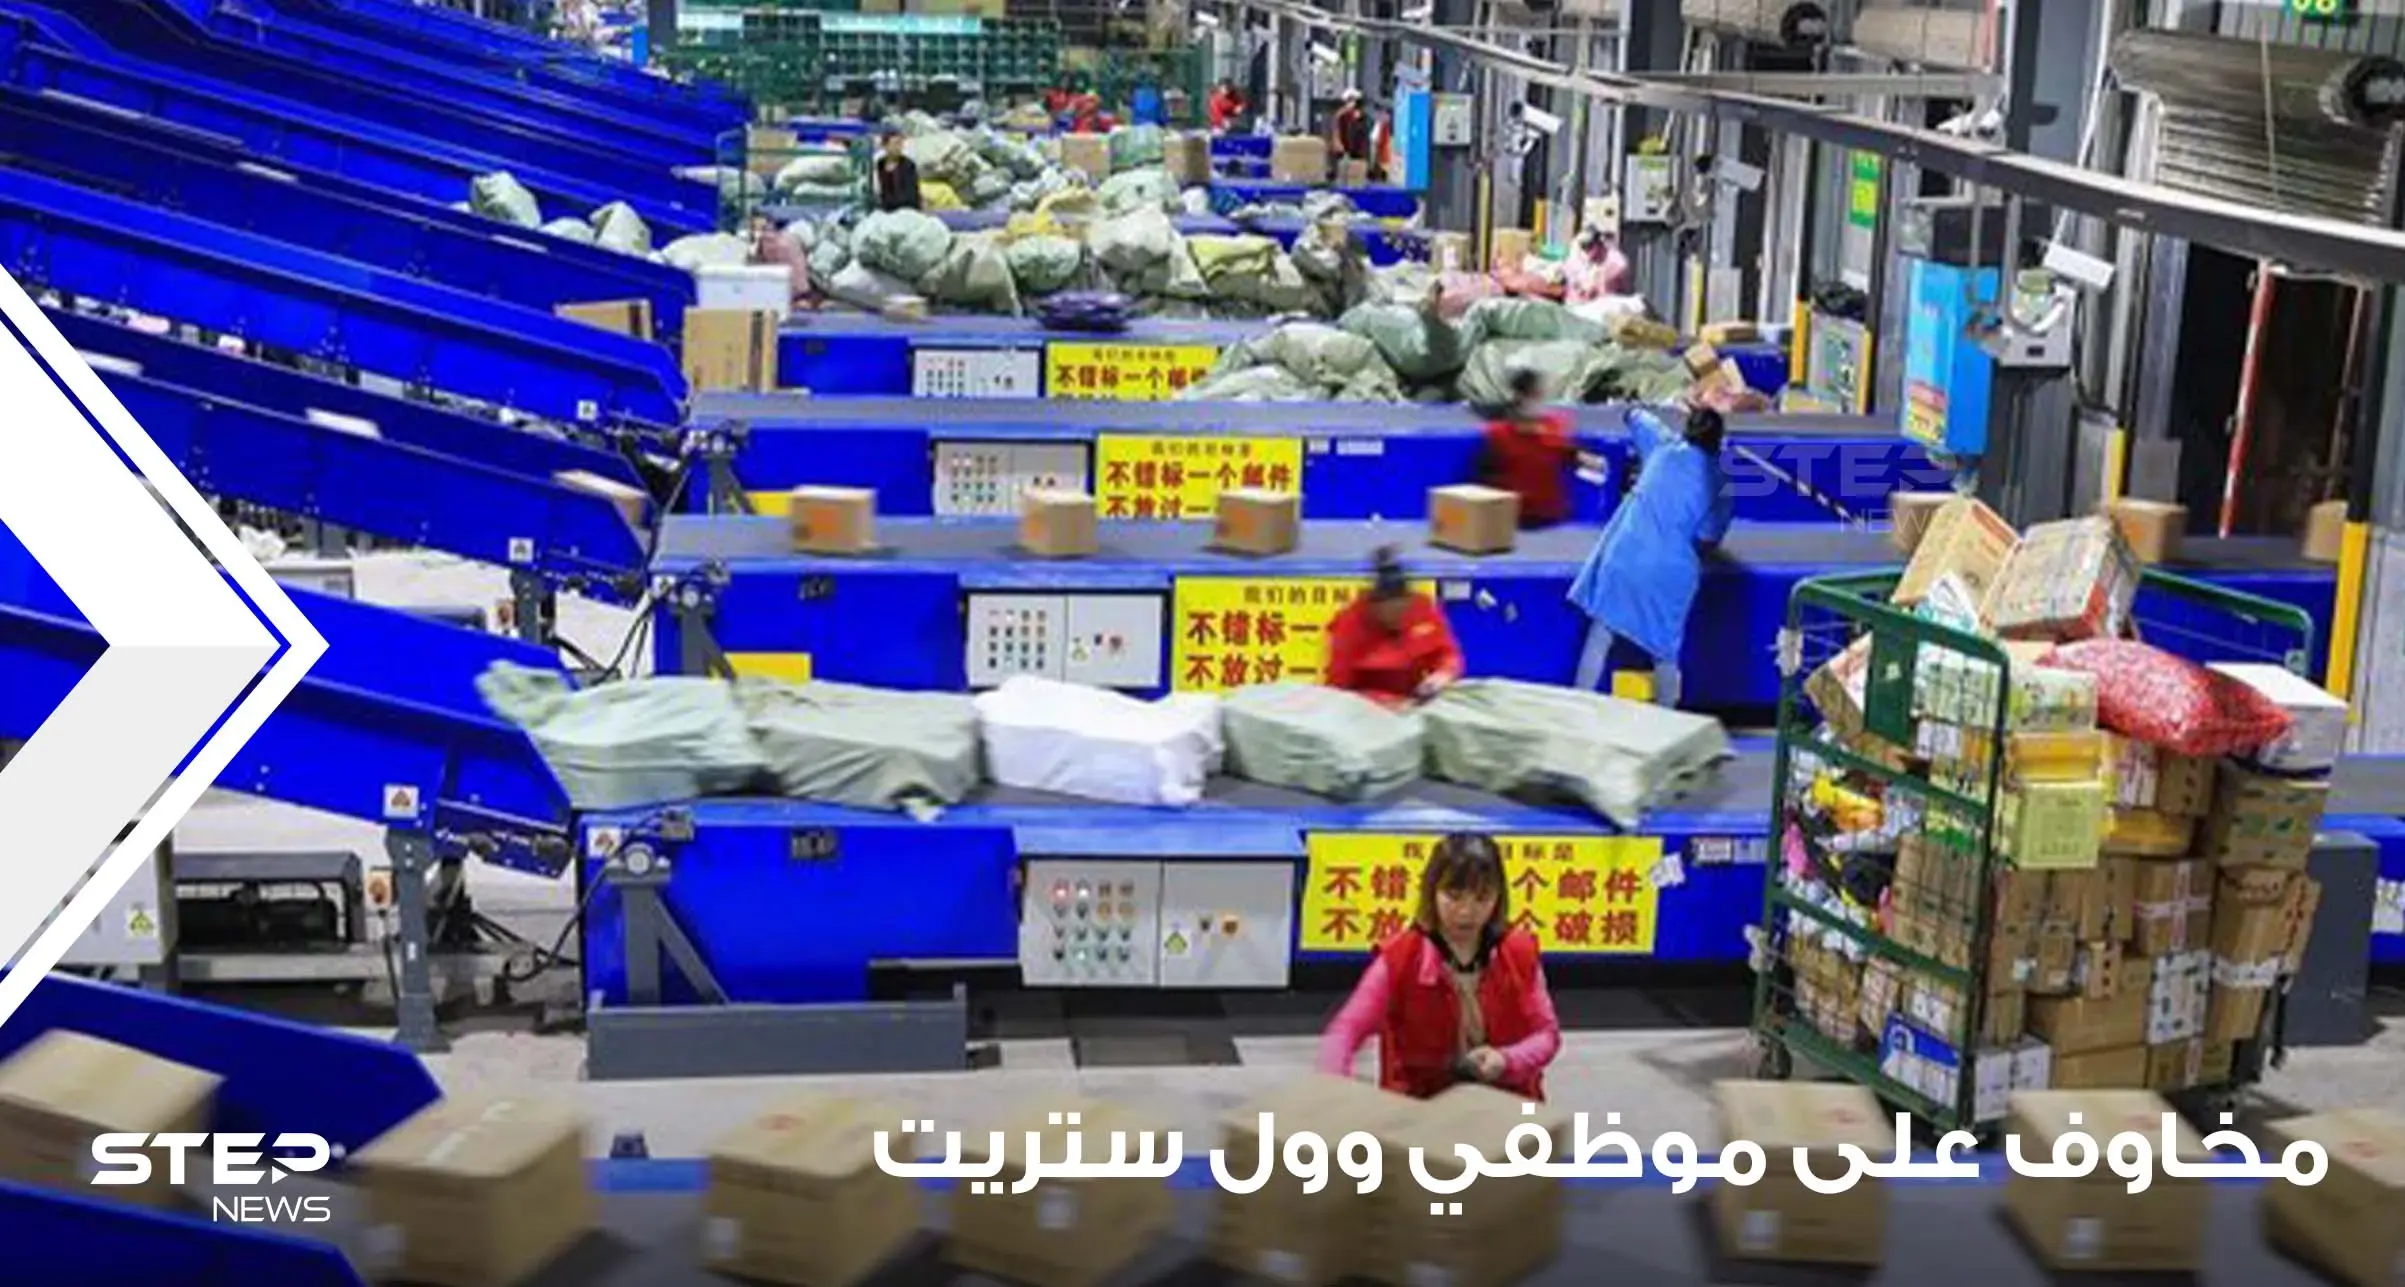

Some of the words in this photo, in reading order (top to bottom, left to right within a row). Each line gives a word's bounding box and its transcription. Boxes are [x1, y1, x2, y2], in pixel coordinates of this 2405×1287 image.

[1186, 610, 1332, 646] 不错标一
[1185, 654, 1328, 688] 不放过一
[1323, 865, 1642, 903] 不错个邮件
[1321, 907, 1639, 945] 不放个破损
